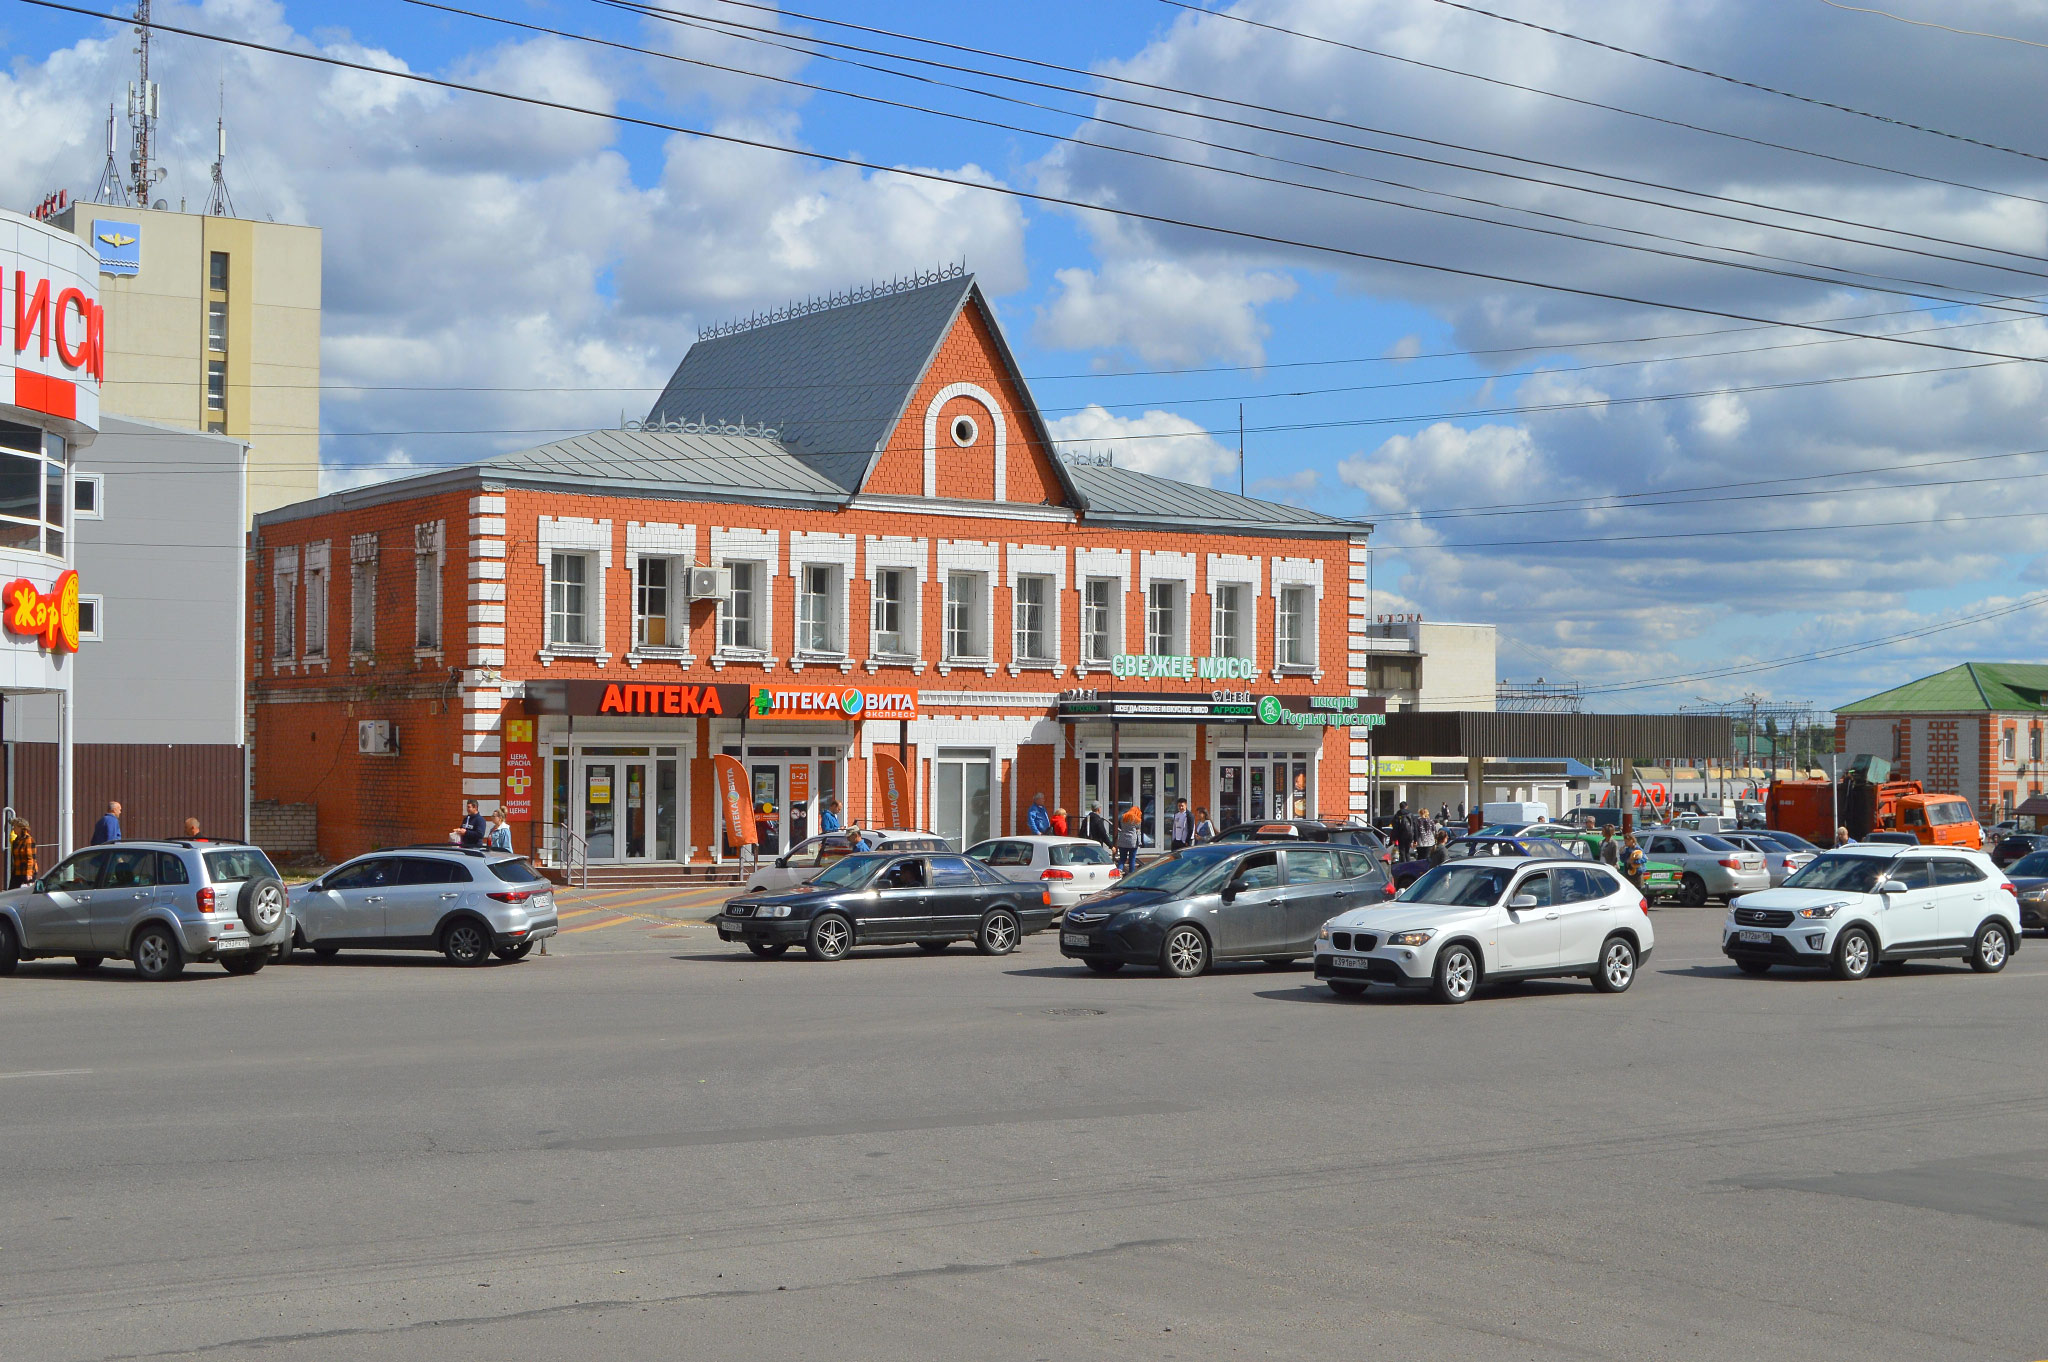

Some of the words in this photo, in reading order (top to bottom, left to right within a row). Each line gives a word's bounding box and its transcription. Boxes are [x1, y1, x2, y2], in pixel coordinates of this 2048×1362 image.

[0, 265, 104, 389] ИСК
[15, 588, 59, 640] Жар
[1112, 655, 1194, 678] СВЕЖЕЕ
[1199, 657, 1252, 679] МЯСО
[601, 684, 723, 714] АПТЕКА
[865, 693, 914, 711] ВИТА
[1114, 704, 1137, 714] ВСЕГДА
[1214, 706, 1253, 714] АГРОЭКО
[1310, 696, 1358, 712] пекарня
[1282, 708, 1327, 730] Родные
[1327, 713, 1386, 730] просторы
[727, 767, 736, 791] ВИТА
[887, 766, 896, 790] ВИТА
[731, 801, 743, 837] АПТЕКА
[891, 800, 901, 829] ПТЕКА
[1275, 794, 1283, 820] ОРТЫ
